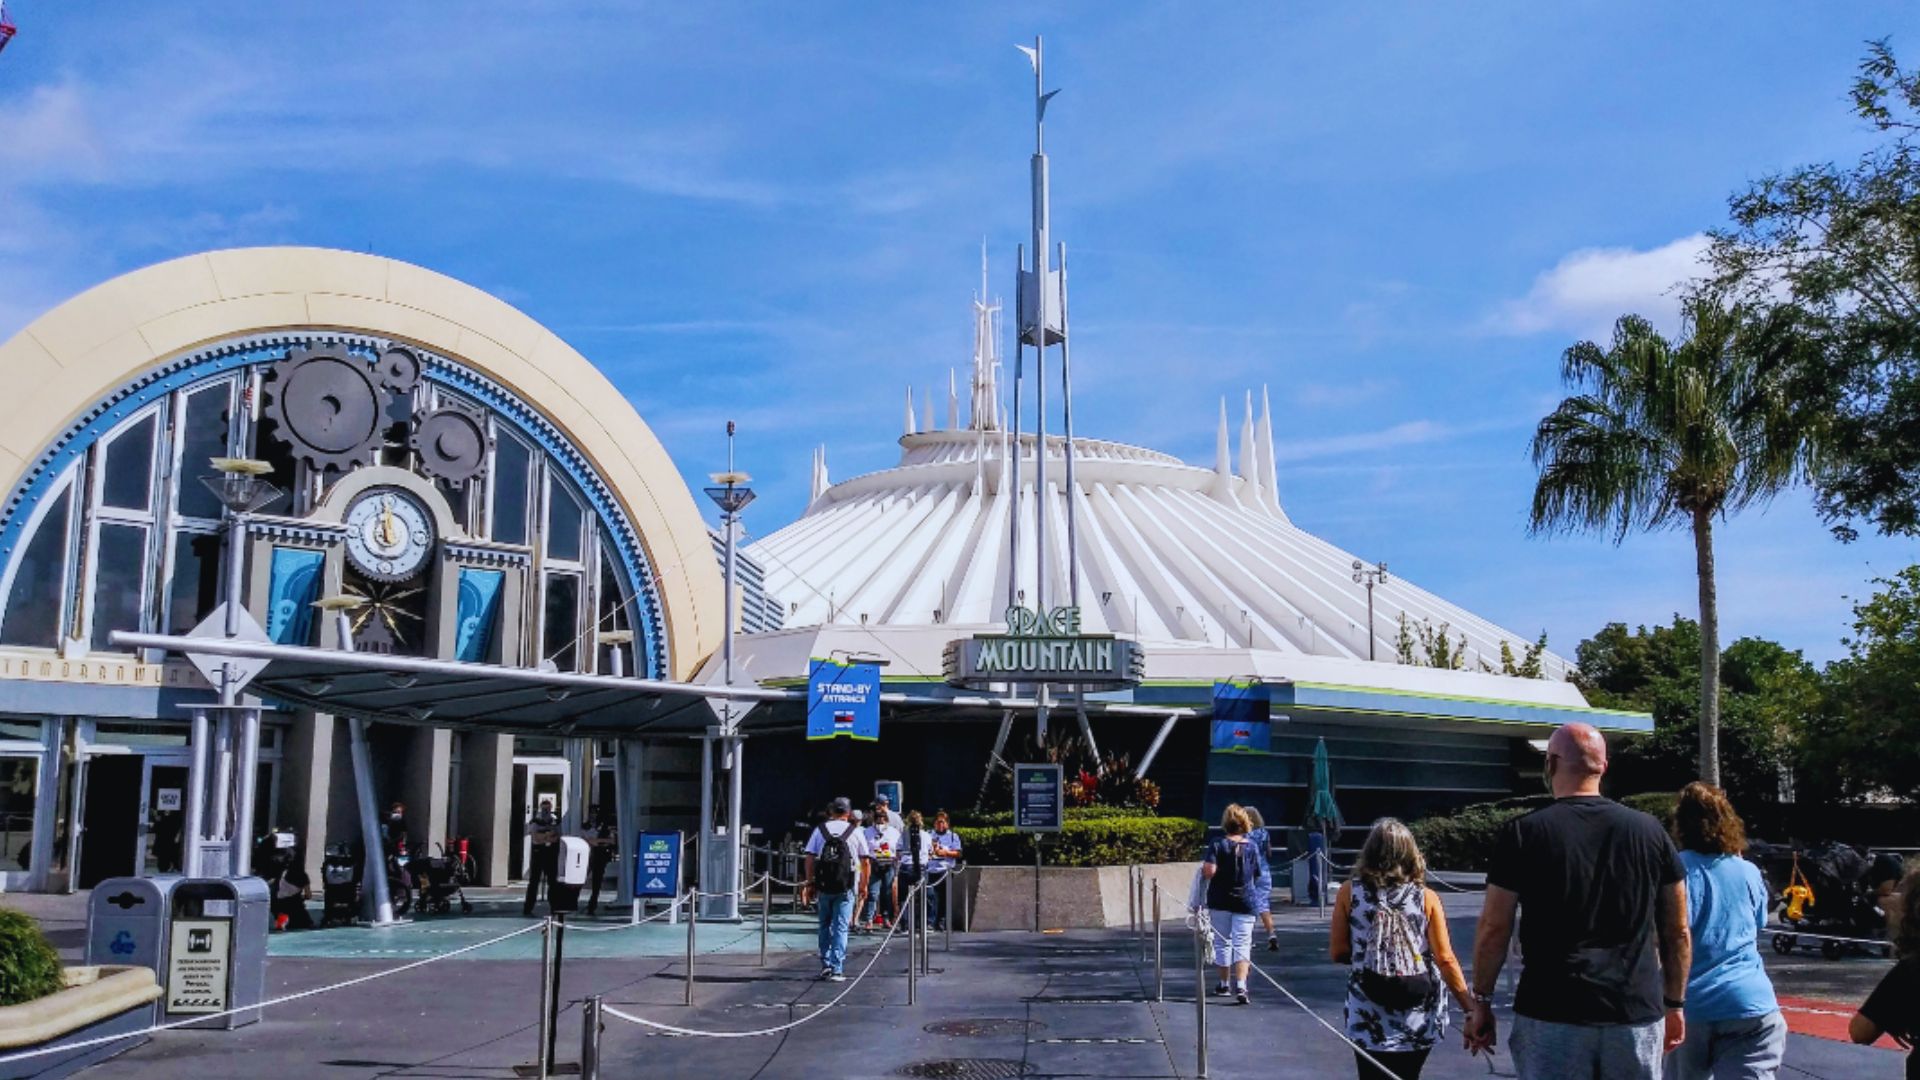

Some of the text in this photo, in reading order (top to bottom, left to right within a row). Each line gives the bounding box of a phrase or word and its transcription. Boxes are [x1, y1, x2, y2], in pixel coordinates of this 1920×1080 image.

[1005, 605, 1081, 637] SPACE
[976, 640, 1112, 671] MOUNTAIN
[817, 682, 872, 695] STAND-BY
[822, 694, 866, 703] ENTRANCE
